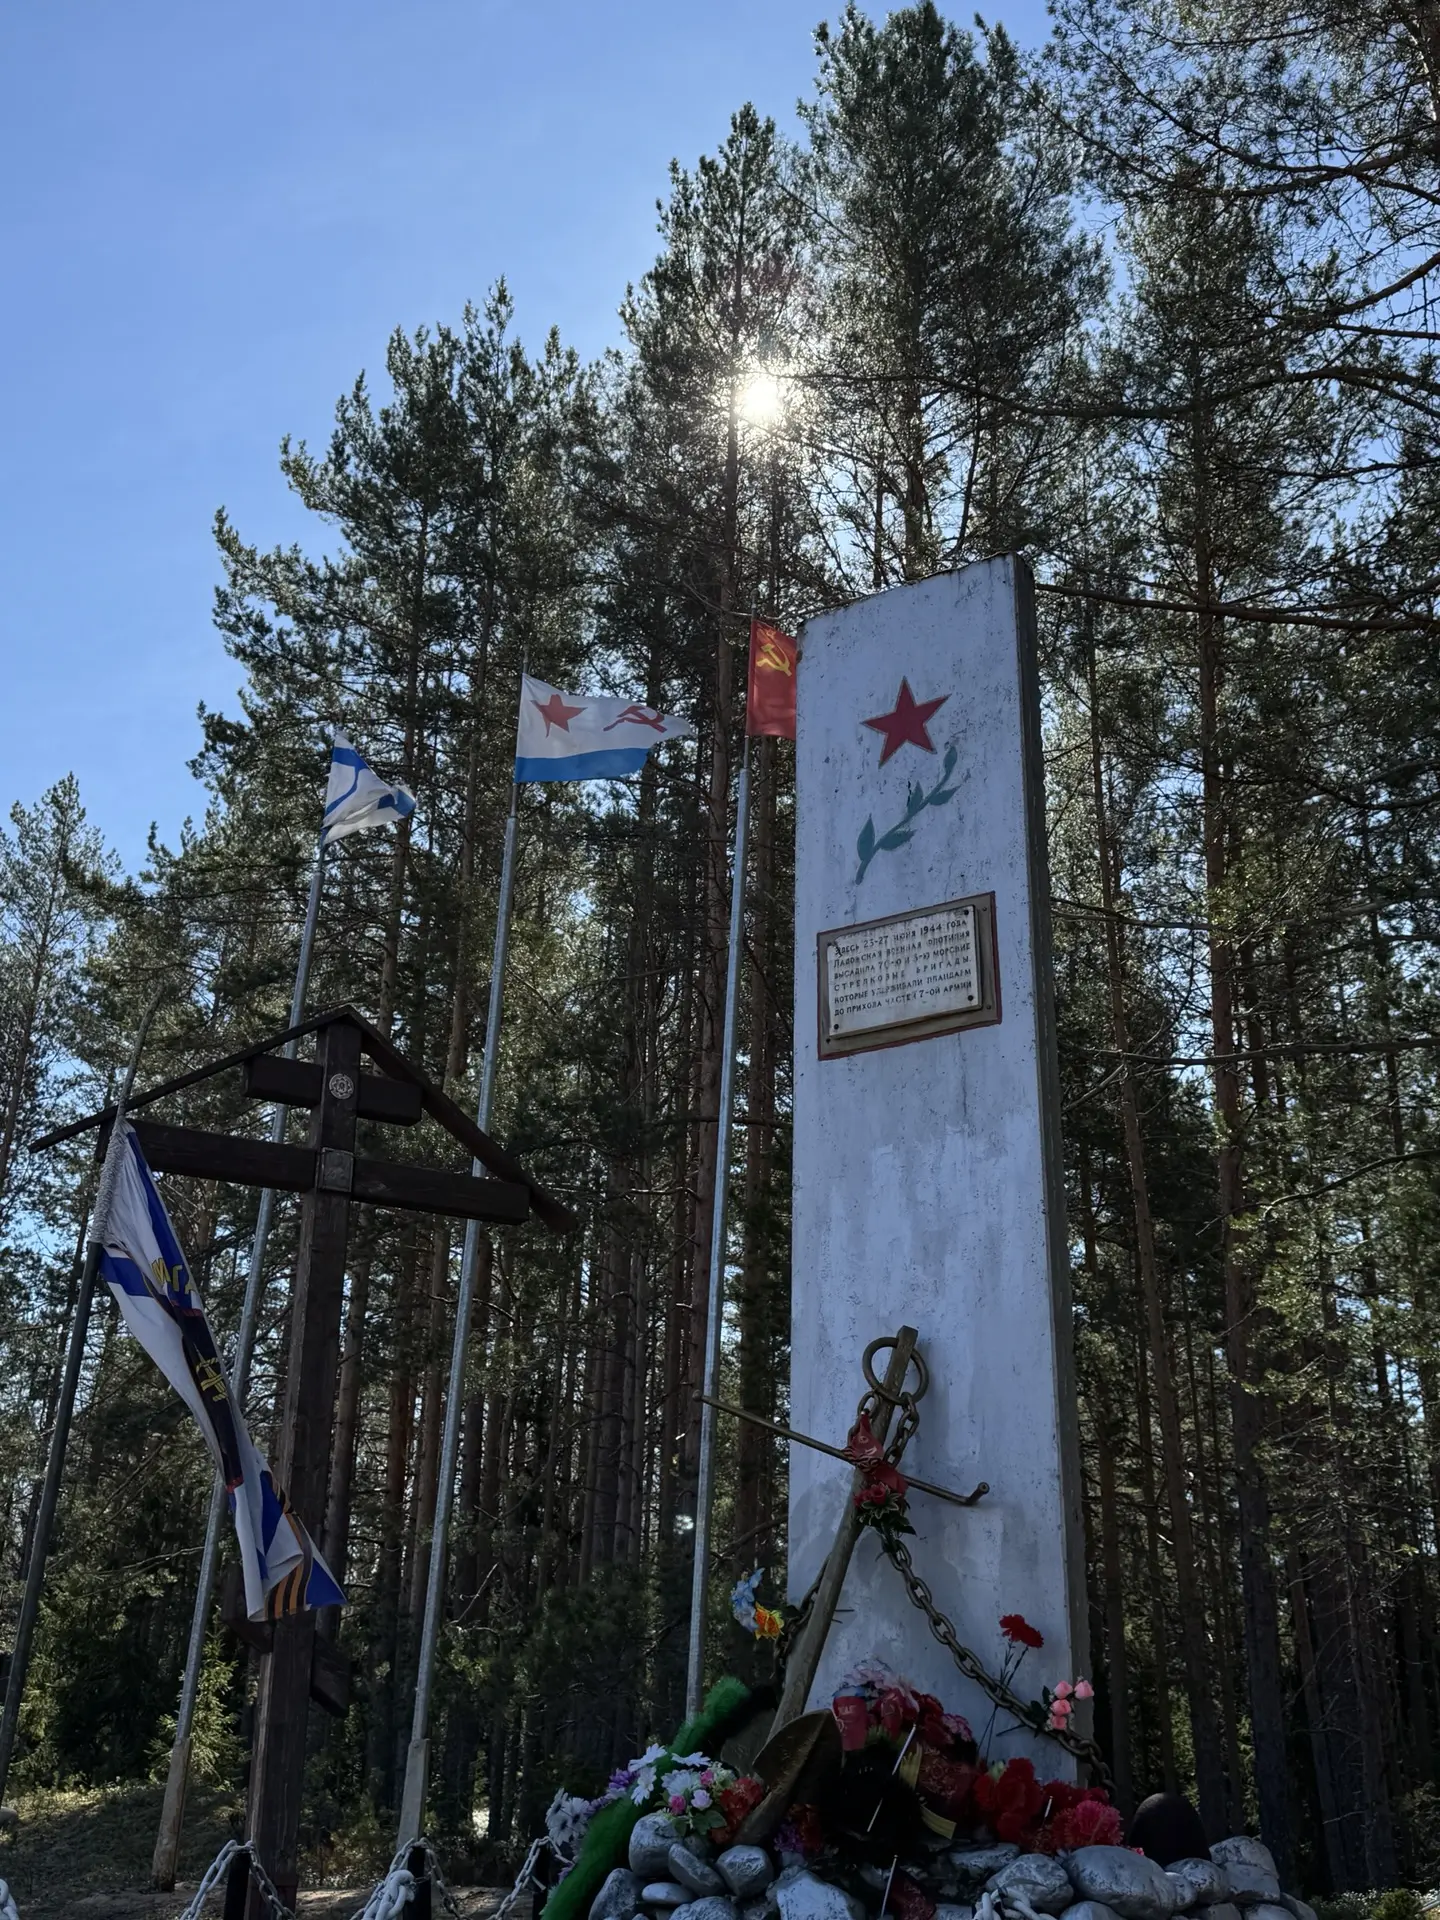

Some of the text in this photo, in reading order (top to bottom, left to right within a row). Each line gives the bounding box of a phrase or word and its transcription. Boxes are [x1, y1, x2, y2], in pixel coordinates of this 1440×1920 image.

[920, 923, 942, 935] 1944
[946, 919, 967, 929] ГОДА
[834, 965, 875, 980] ВЫСАДИЛА
[933, 943, 971, 956] МОРСКИЕ
[834, 990, 868, 1004] КОТОРЫЕ
[834, 1009, 845, 1017] ДО
[846, 1001, 882, 1014] ПРИХОДА
[919, 987, 941, 999] 7-ОЙ
[943, 981, 972, 993] АРМИИ
